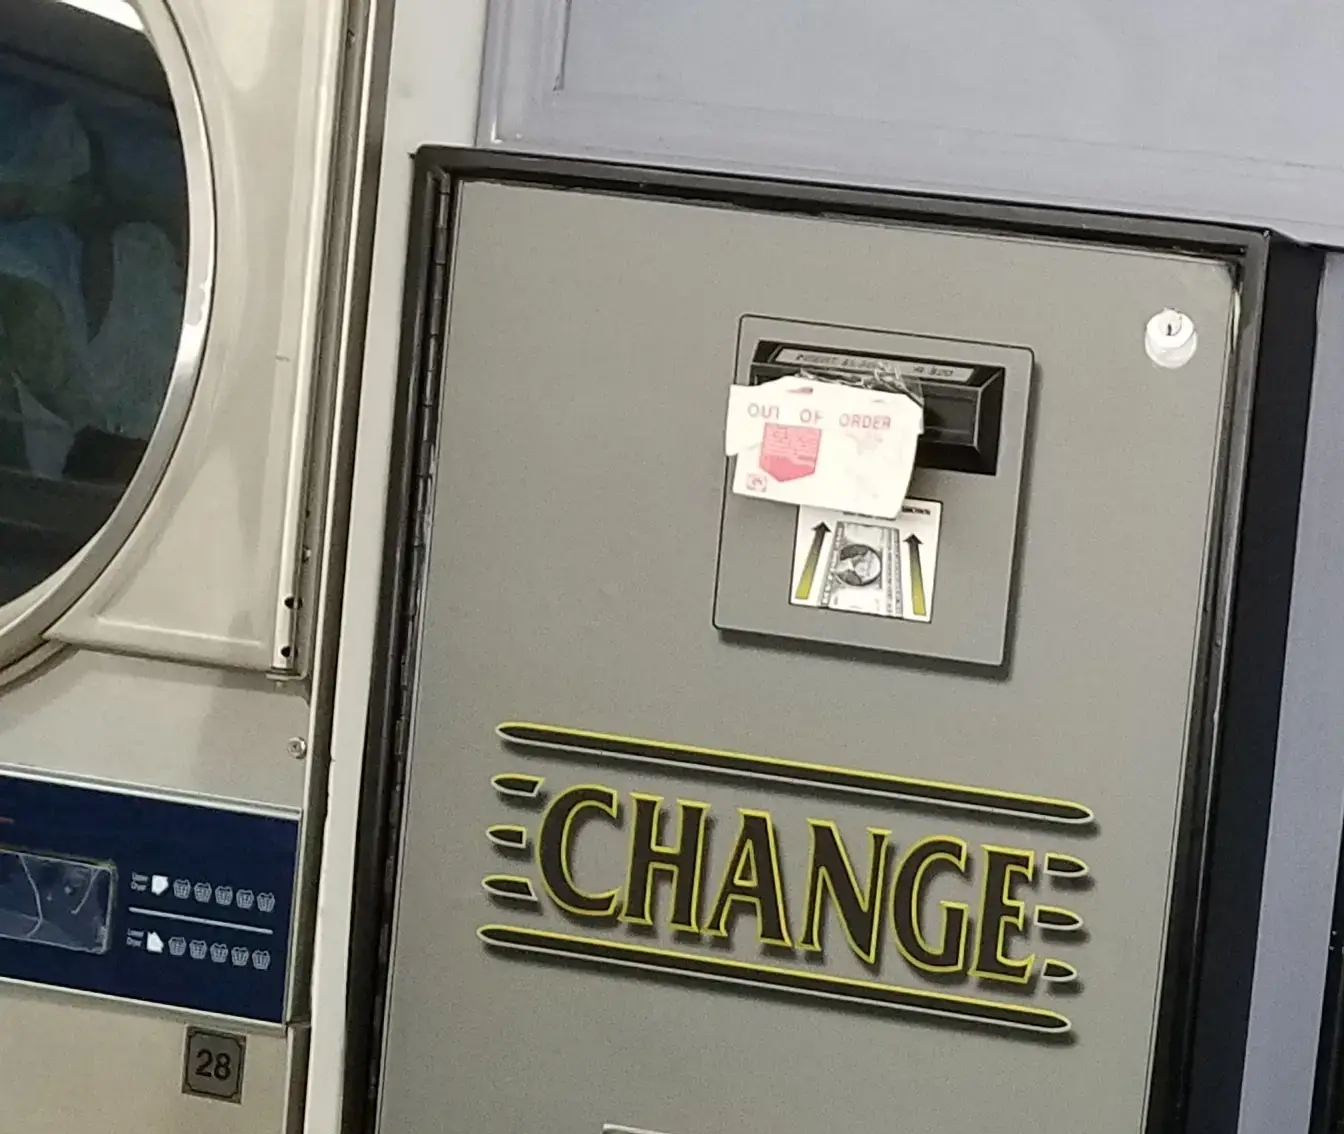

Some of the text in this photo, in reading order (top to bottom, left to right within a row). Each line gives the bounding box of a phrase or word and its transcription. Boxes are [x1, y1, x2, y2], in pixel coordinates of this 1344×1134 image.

[747, 403, 892, 430] OUT OF ORDER
[536, 783, 1037, 984] CHANGE
[194, 1048, 232, 1082] 28
